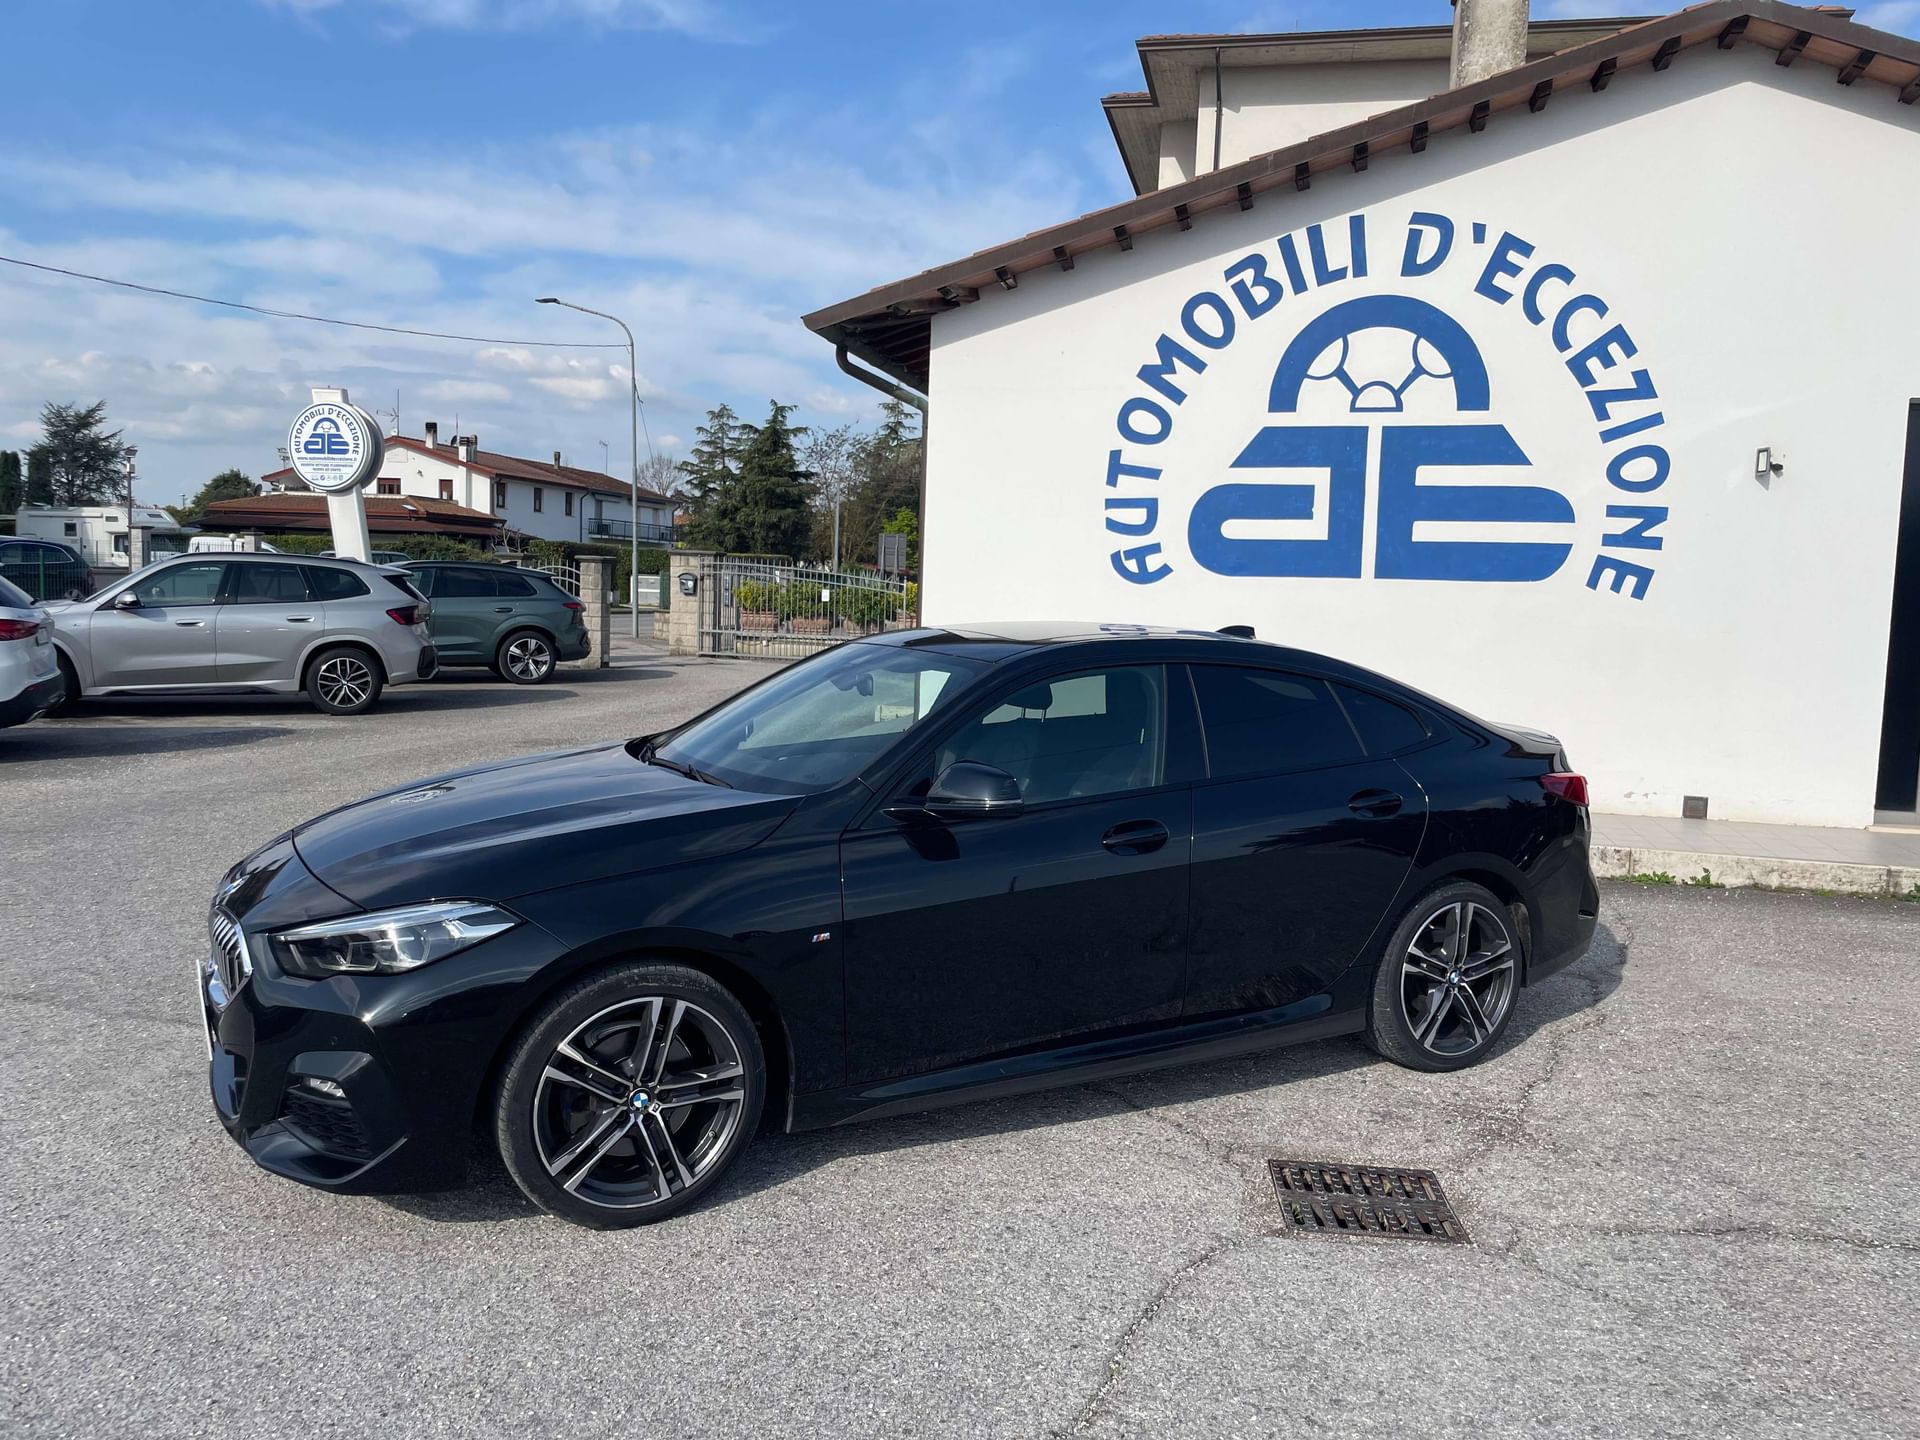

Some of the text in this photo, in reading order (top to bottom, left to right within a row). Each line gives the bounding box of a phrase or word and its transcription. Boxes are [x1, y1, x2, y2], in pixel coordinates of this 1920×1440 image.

[294, 407, 360, 456] AUTOMOBILI D'ECCEZIONE
[1104, 212, 1670, 600] AUTOMOBILI D'ECCEZIONE
